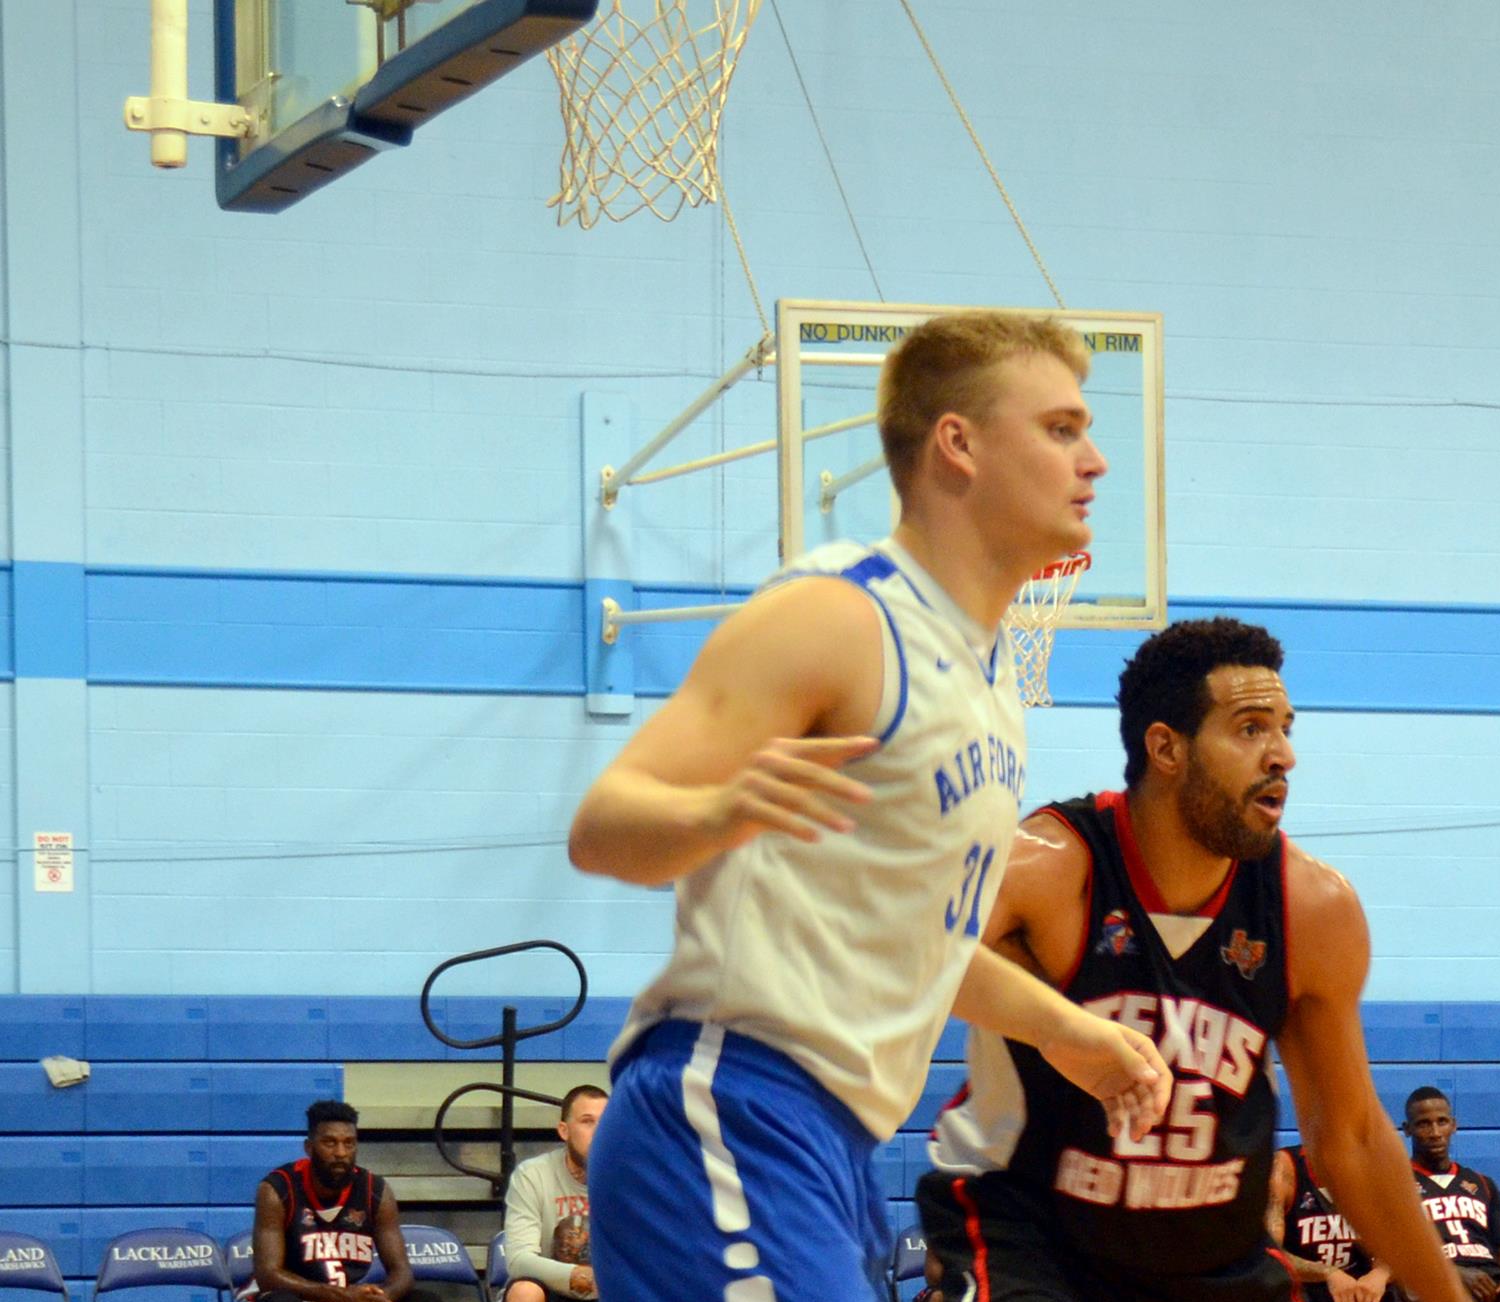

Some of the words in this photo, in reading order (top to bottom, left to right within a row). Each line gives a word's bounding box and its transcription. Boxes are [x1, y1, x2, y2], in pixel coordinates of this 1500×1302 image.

[800, 323, 828, 341] NO
[1105, 334, 1139, 352] RIM
[935, 741, 986, 815] AIR
[945, 842, 996, 937] 31
[1445, 1219, 1470, 1244] 4
[112, 1244, 213, 1261] LACKLAND
[301, 1231, 373, 1263] TEXAS
[1317, 1242, 1353, 1268] 35
[158, 1258, 214, 1269] WARHAWKS
[325, 1260, 347, 1288] 5
